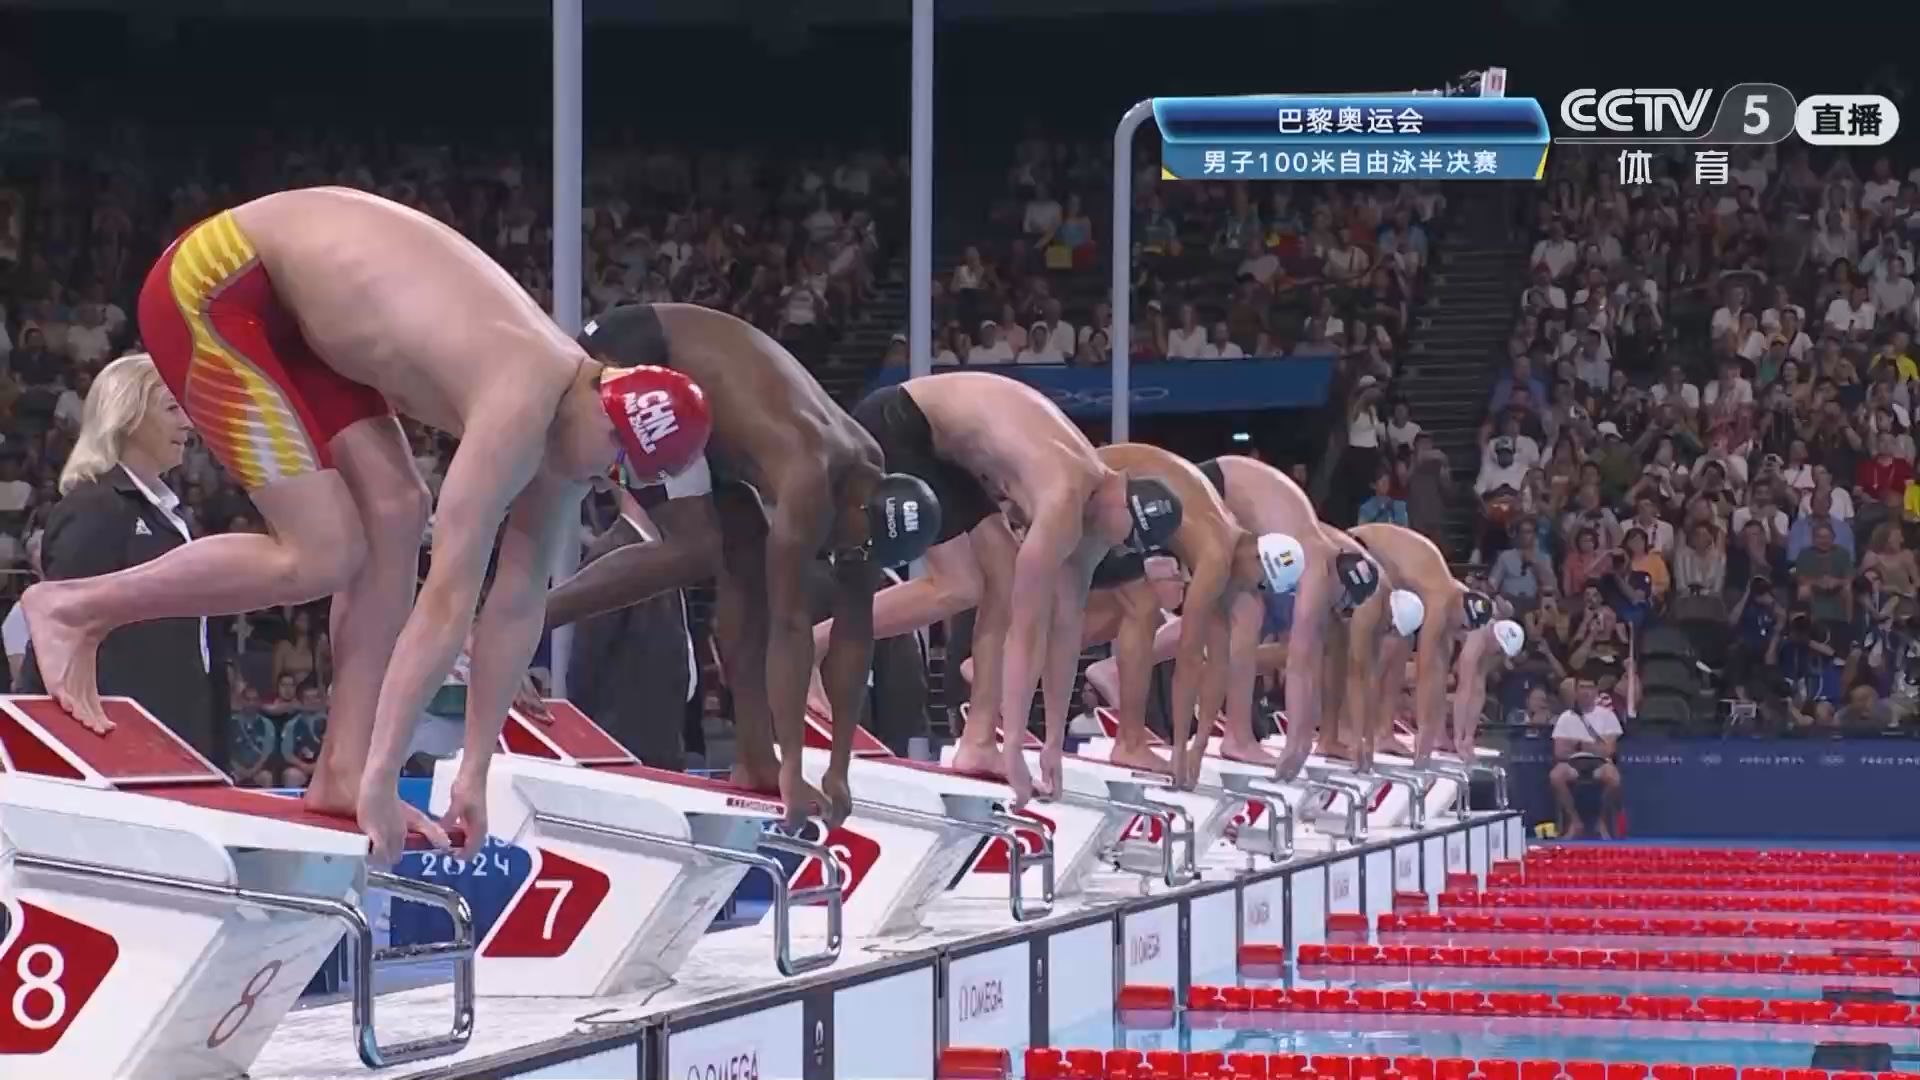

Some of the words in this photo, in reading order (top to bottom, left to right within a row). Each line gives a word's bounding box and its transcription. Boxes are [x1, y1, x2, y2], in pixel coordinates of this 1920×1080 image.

[636, 389, 680, 442] CHN
[903, 500, 919, 532] CAN
[421, 852, 510, 877] 2024
[535, 879, 574, 940] 7
[11, 943, 67, 1030] 8
[207, 959, 283, 1049] 8
[969, 979, 1004, 1017] OMEGA
